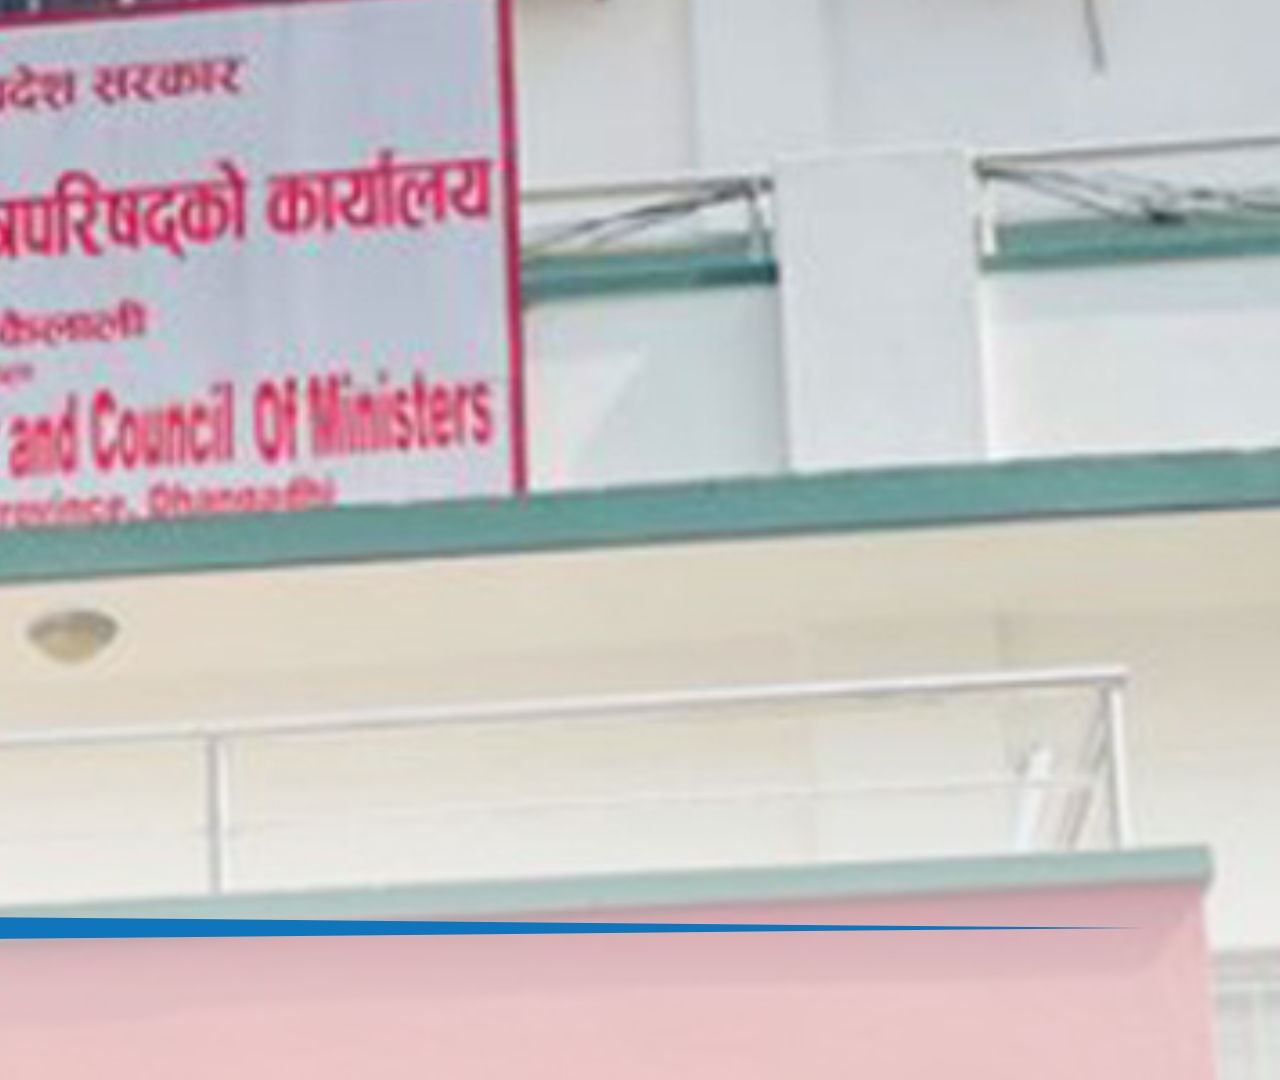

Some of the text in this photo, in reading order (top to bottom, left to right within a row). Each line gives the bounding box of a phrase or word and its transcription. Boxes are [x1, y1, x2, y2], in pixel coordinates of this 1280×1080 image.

[91, 56, 244, 104] सरकार
[264, 150, 491, 234] कार्यालय
[8, 393, 78, 477] and
[90, 380, 236, 469] Council
[253, 375, 300, 463] Of
[308, 368, 496, 458] Ministers
